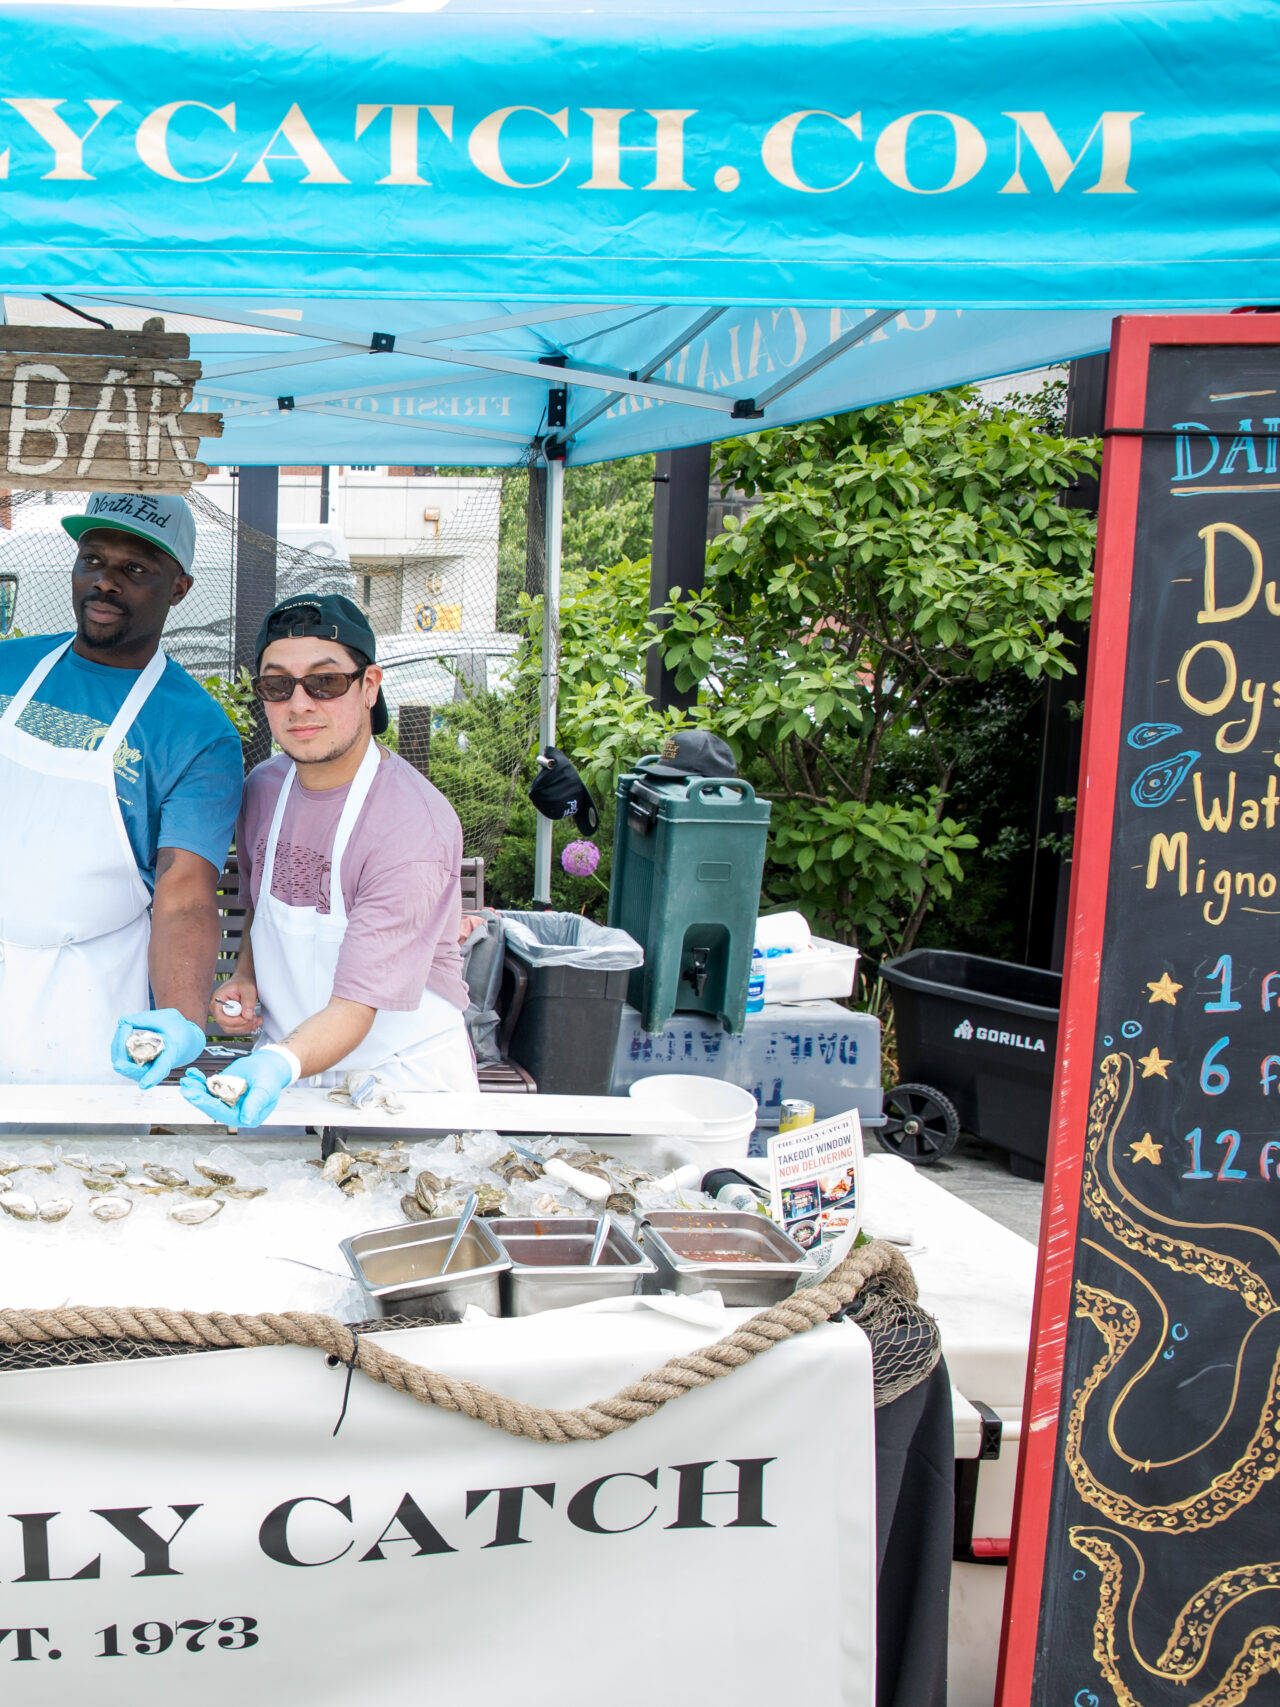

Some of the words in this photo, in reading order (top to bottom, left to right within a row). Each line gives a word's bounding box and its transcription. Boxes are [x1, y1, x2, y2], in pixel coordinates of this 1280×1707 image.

[90, 495, 133, 515] North
[132, 500, 172, 528] End
[1146, 832, 1277, 925] Migno
[1204, 954, 1242, 1013] 1
[976, 1027, 1046, 1052] GORILLA
[1200, 1036, 1231, 1097] 6
[777, 1146, 814, 1166] TAKEOUT
[815, 1134, 852, 1155] WINDOW
[779, 1164, 799, 1178] NOW
[802, 1146, 853, 1172] DELIVERING
[1181, 1128, 1248, 1182] 12
[258, 1457, 778, 1568] CATCH
[94, 1616, 260, 1657] 1973
